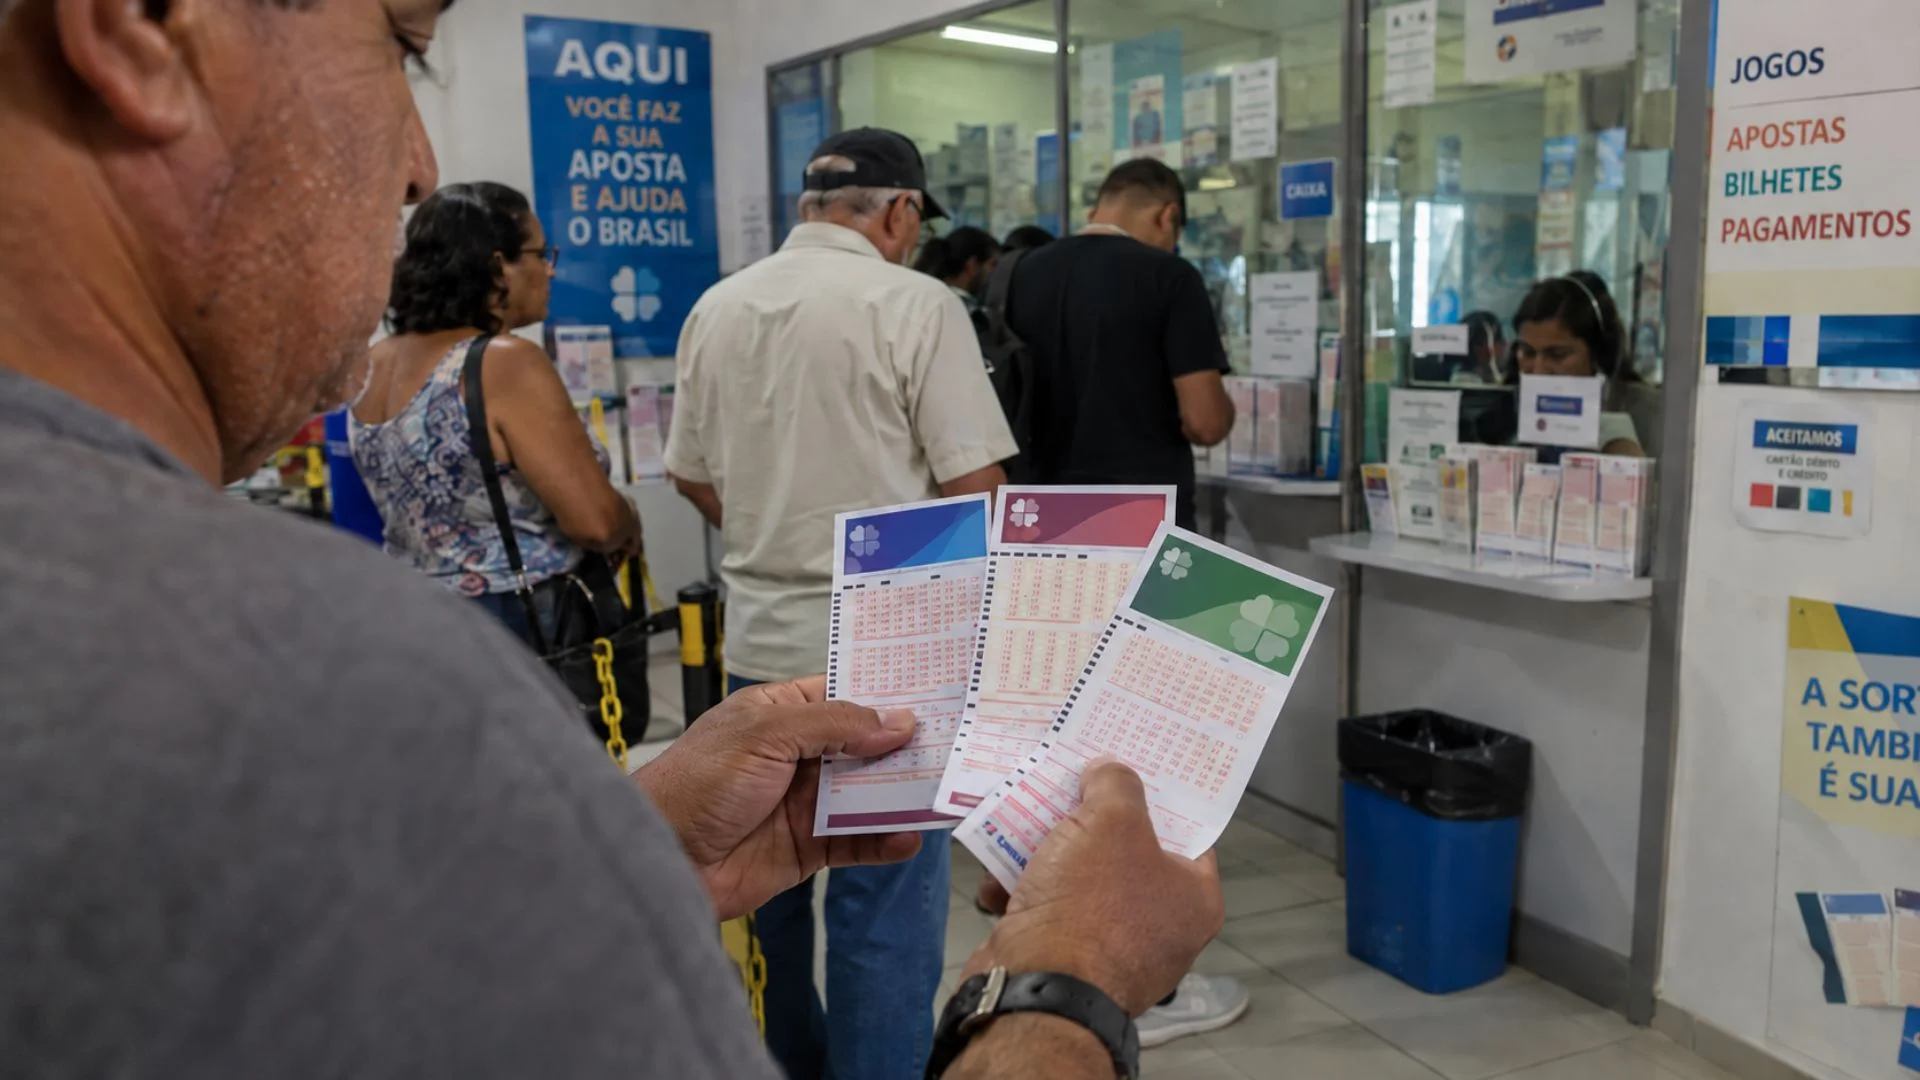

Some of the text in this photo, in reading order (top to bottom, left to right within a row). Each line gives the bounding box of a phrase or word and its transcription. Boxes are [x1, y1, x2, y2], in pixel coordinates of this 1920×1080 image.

[554, 40, 688, 84] AQUI
[1730, 47, 1825, 84] JOGOS
[565, 94, 682, 123] VOCÊ FAZ
[592, 124, 663, 149] A SUA
[1727, 116, 1846, 152] APOSTAS
[568, 150, 687, 183] APOSTA
[1724, 164, 1842, 197] BILHETES
[571, 185, 687, 213] E AJUDA
[1286, 181, 1328, 200] CAIXA
[568, 217, 693, 247] O BRASIL
[1721, 208, 1911, 244] PAGAMENTOS
[1766, 427, 1843, 447] ACEITAMOS
[1766, 454, 1840, 469] CARTÃO DÉBITO
[1778, 468, 1828, 481] E CRÉDITO
[1802, 677, 1920, 715] A SOR
[1820, 761, 1920, 811] É SUA
